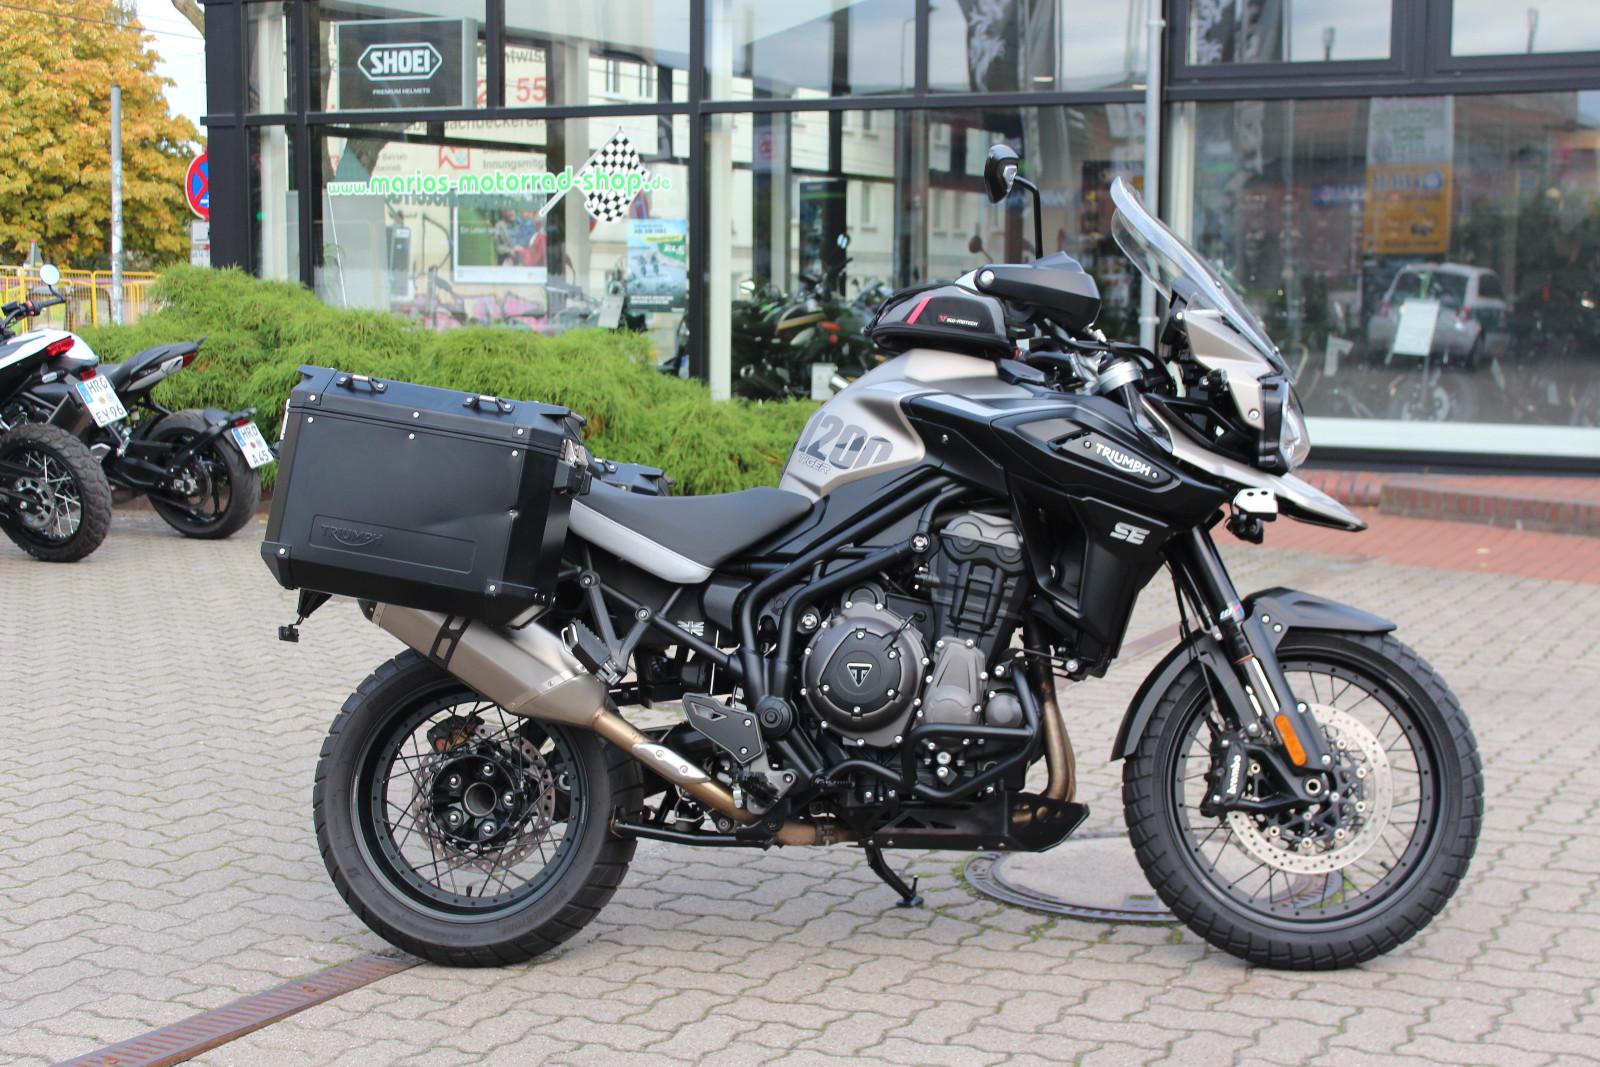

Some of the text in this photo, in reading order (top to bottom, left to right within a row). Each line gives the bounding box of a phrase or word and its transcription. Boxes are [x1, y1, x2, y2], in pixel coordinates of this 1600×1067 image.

[370, 49, 430, 74] SHOEI
[516, 76, 547, 102] 55
[328, 166, 672, 198] www.marios-motorrad-shop.de
[799, 452, 832, 475] TIGER
[1095, 442, 1152, 477] TRIUMPH
[1109, 521, 1151, 545] SE
[1226, 754, 1242, 794] brembo
